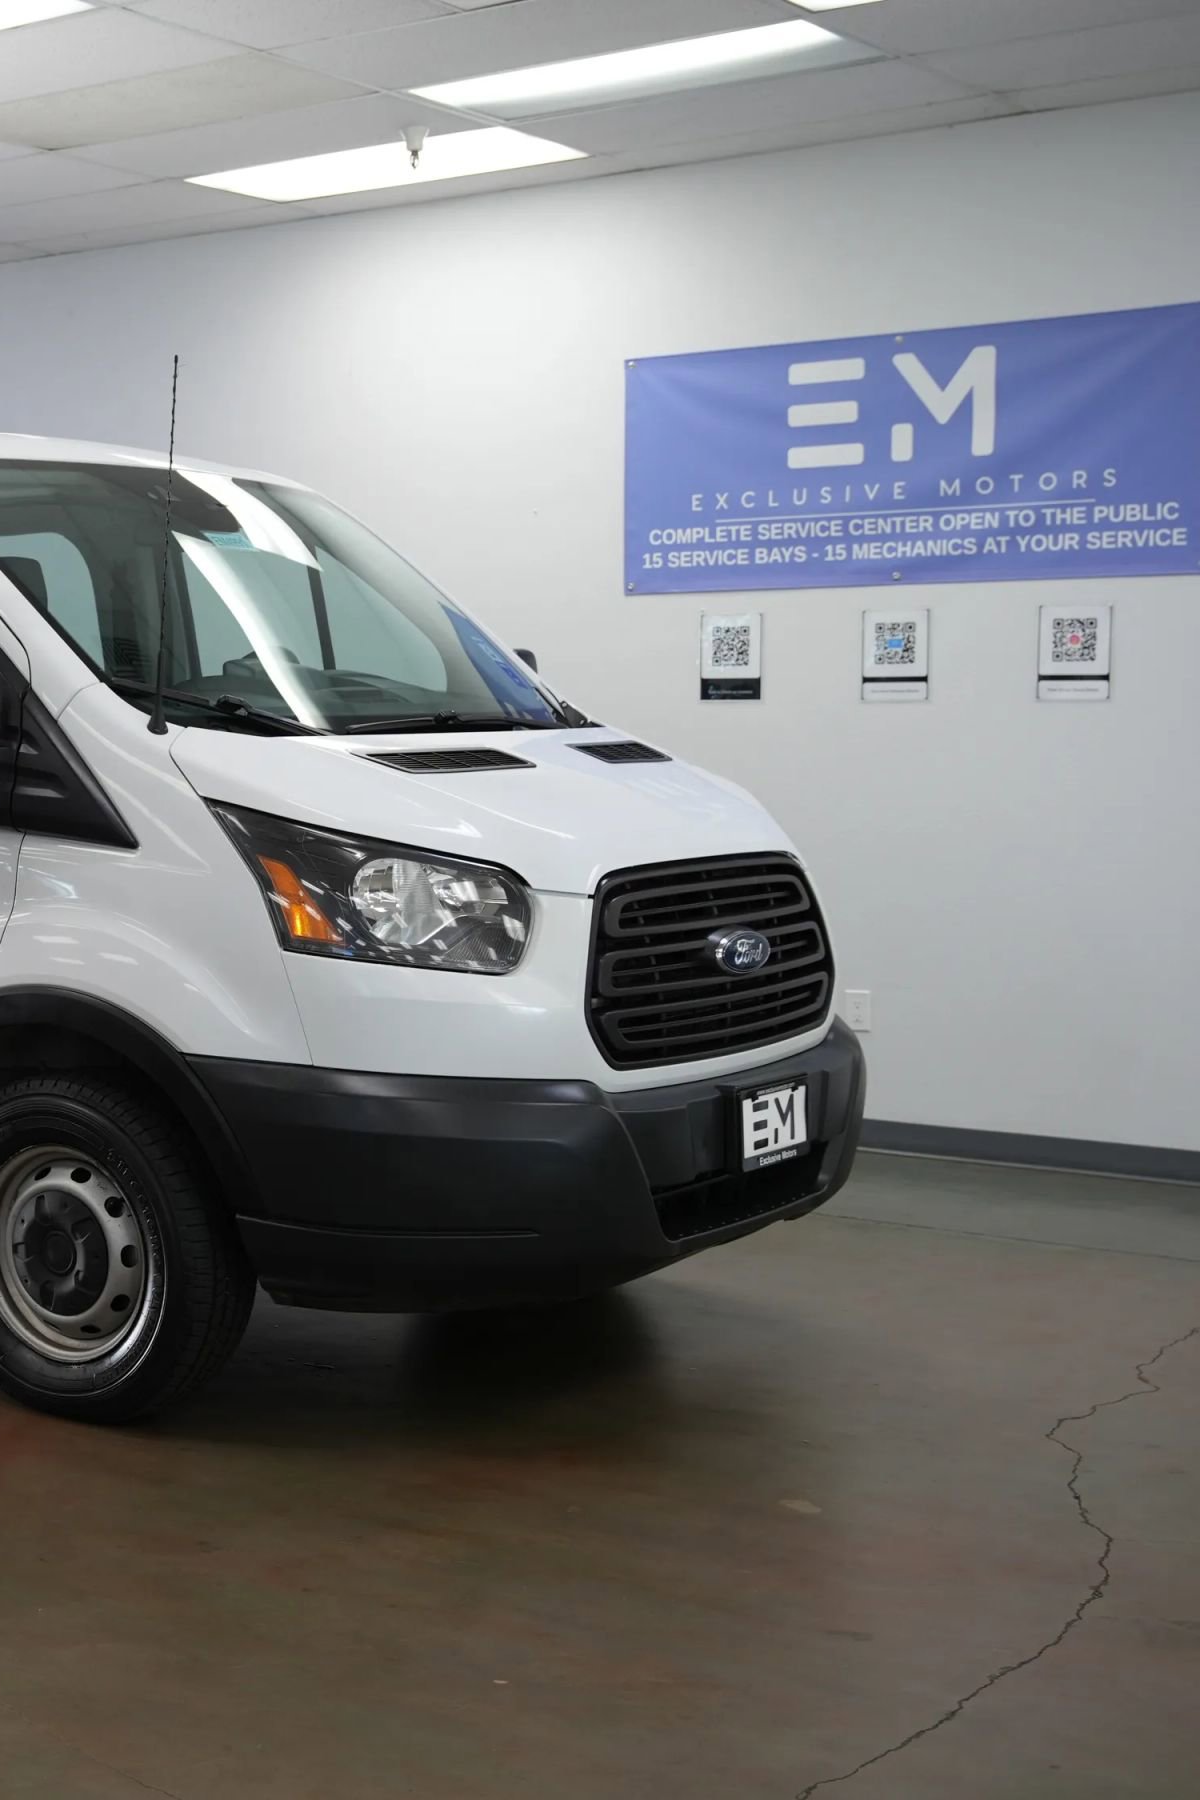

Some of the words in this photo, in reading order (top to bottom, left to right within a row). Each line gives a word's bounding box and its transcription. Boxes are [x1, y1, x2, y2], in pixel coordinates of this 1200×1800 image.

[787, 345, 997, 470] EM
[691, 481, 906, 512] EXCLUSIVE
[939, 468, 1118, 498] MOTORS
[648, 524, 753, 546] COMPLETE
[757, 519, 844, 541] SERVICE
[848, 515, 934, 537] CENTER
[938, 511, 1000, 532] OPEN
[1004, 509, 1037, 528] TO
[1041, 506, 1087, 526] THE
[1093, 501, 1181, 524] PUBLIC
[642, 552, 664, 570] 15
[667, 548, 750, 568] SERVICE
[754, 545, 807, 565] BAYS
[824, 543, 847, 562] 15
[851, 537, 978, 561] MECHANICS
[983, 535, 1011, 555] AT
[1015, 532, 1080, 553] YOUR
[1085, 527, 1189, 550] SERVICE
[734, 938, 763, 966] Ford
[752, 1093, 796, 1151] EM
[759, 1153, 782, 1167] Exclusive
[781, 1148, 798, 1160] Motors
